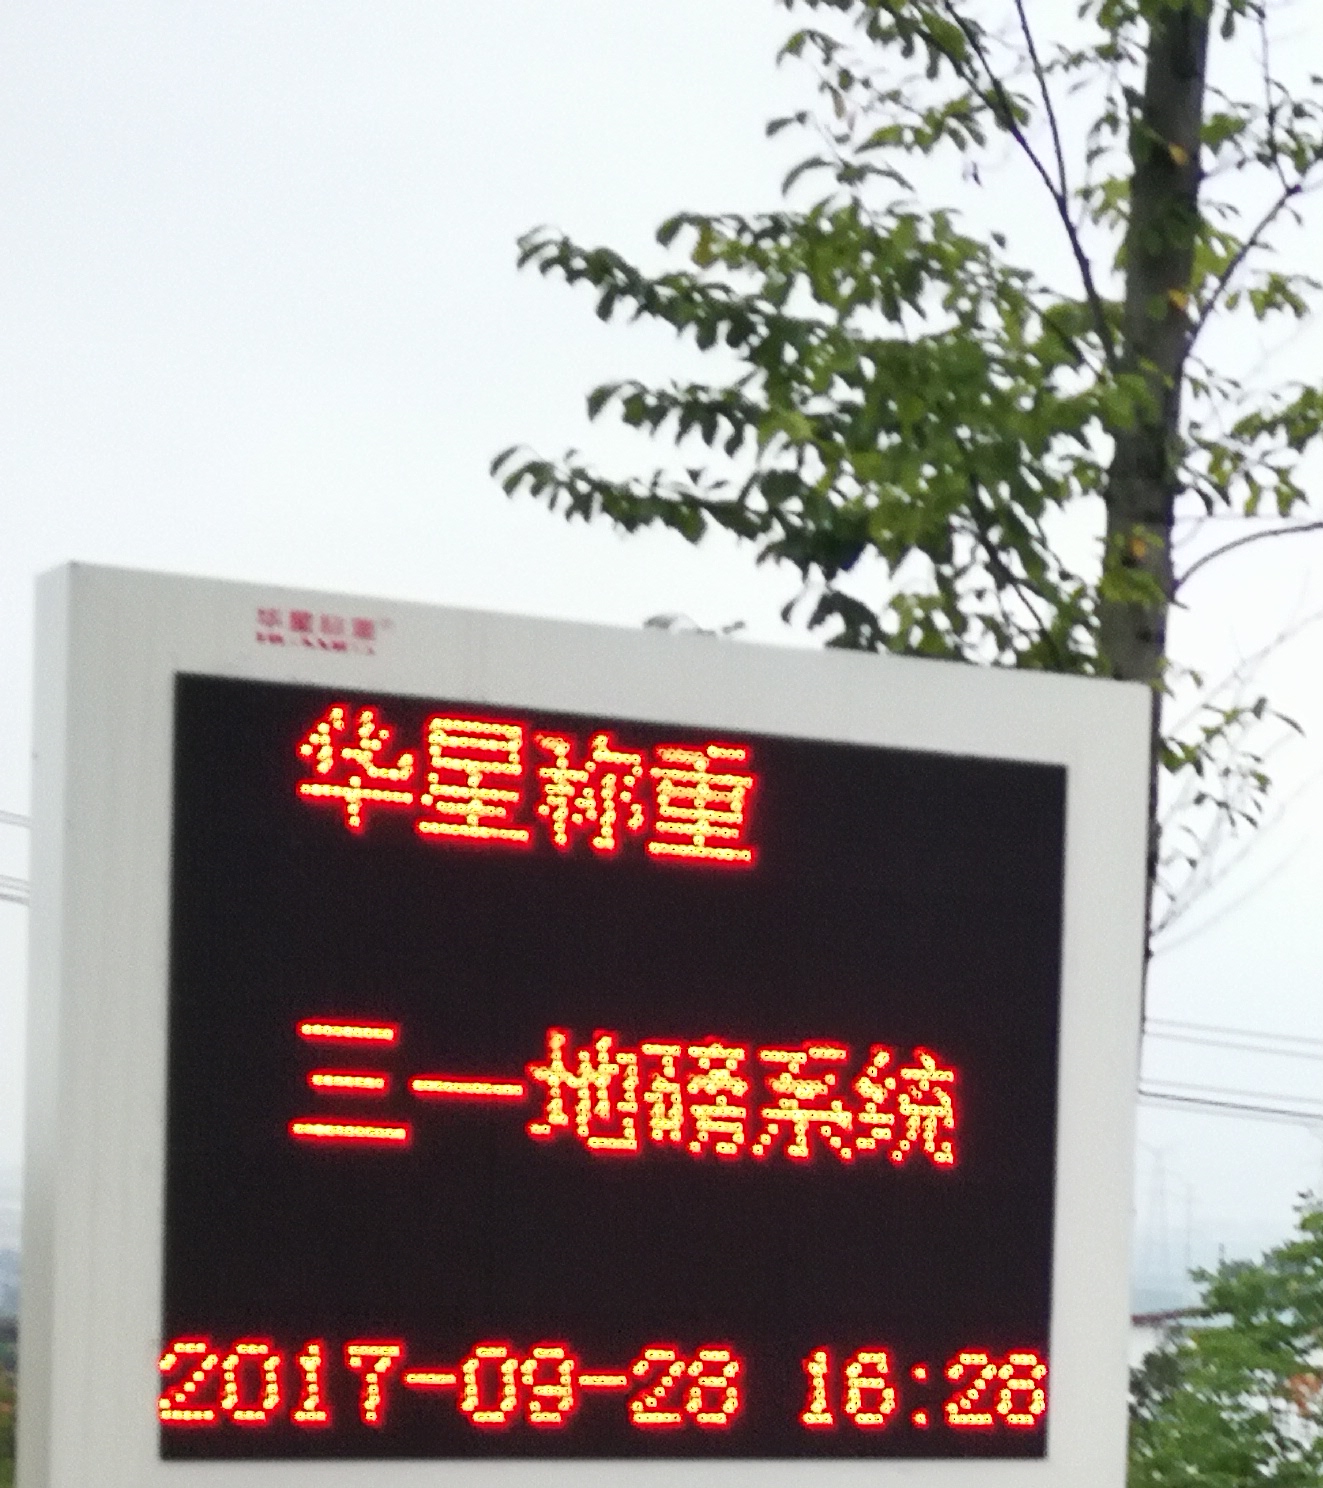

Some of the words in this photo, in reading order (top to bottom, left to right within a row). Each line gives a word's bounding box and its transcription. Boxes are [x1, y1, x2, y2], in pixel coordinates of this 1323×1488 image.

[296, 702, 757, 869] 华星称重
[290, 1020, 960, 1168] 三一地磅系统
[158, 1338, 750, 1428] 2017-09-28
[801, 1344, 1048, 1428] 16:28
